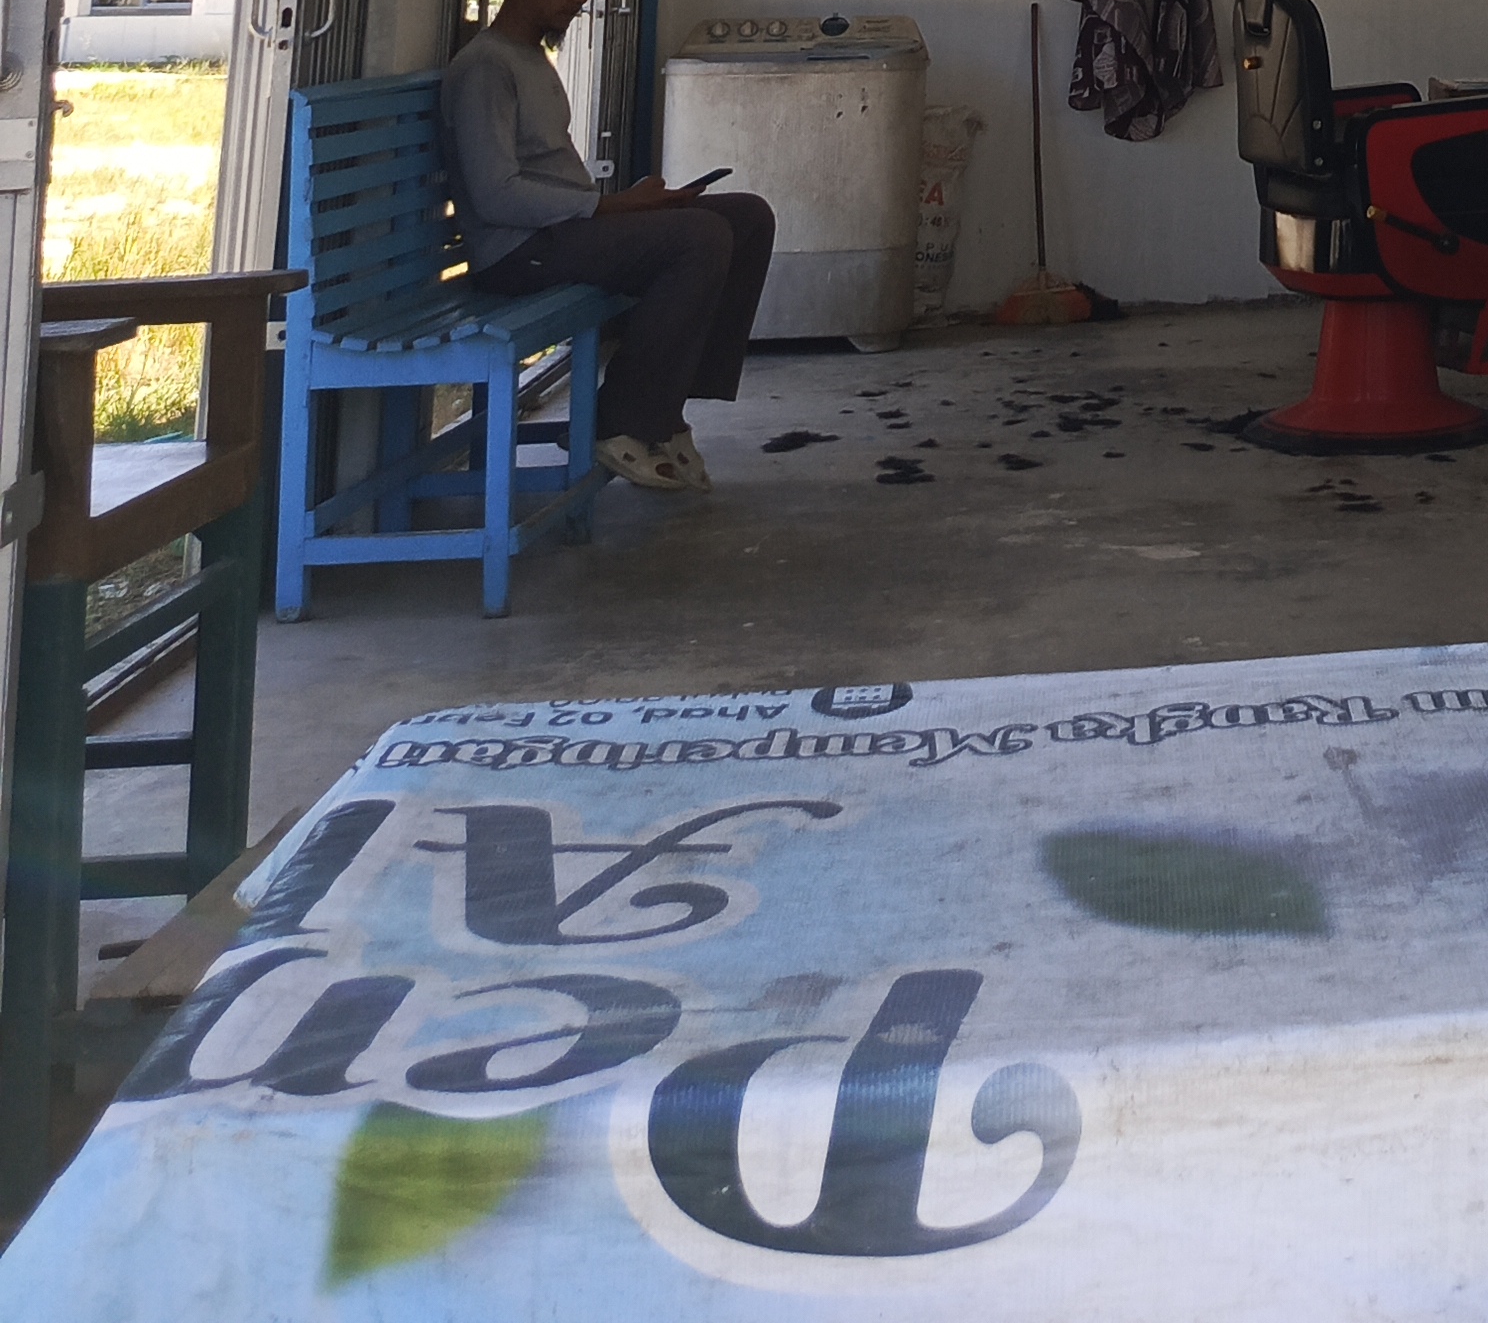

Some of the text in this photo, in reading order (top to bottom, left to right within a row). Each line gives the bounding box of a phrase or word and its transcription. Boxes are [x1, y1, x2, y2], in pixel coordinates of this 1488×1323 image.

[548, 708, 614, 727] 02
[635, 702, 790, 724] Ahad,
[1046, 693, 1399, 746] Rangka
[380, 721, 1033, 771] Memperingati
